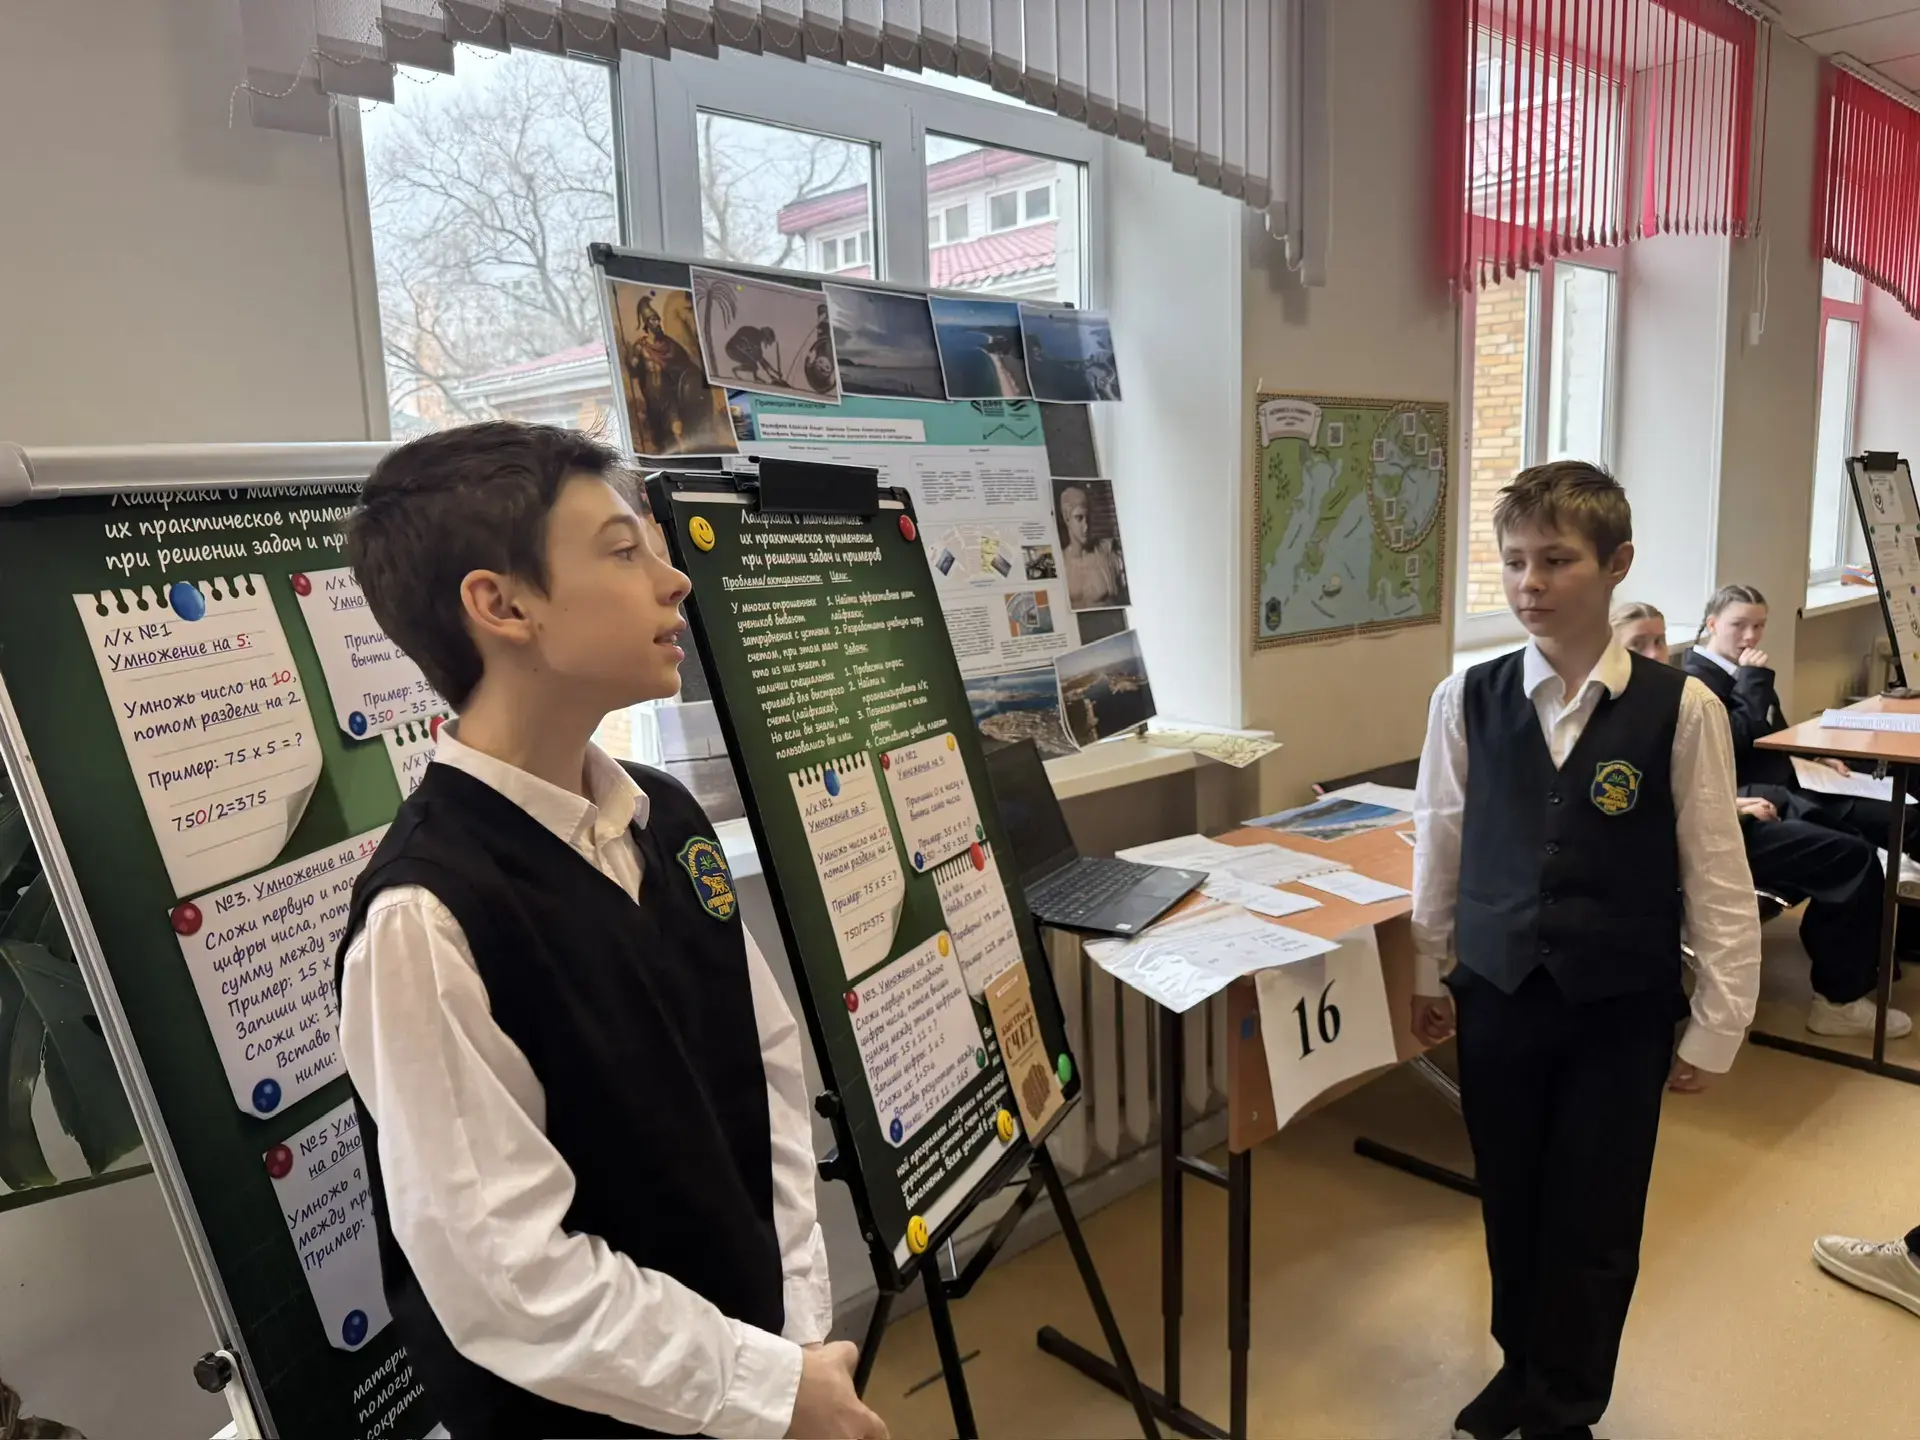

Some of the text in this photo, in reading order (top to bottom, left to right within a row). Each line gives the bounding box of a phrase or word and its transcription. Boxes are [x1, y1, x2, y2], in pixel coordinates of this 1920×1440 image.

[105, 520, 132, 539] их
[139, 511, 283, 542] практическое
[739, 532, 874, 549] их практическое применение
[106, 552, 150, 576] при
[158, 543, 247, 572] решении
[253, 533, 302, 556] задач
[307, 535, 318, 549] и
[741, 547, 882, 571] при решении задач и примеров
[731, 602, 738, 614] У
[742, 601, 771, 613] многих
[737, 612, 806, 633] учеников бывают
[138, 623, 172, 640] №1
[742, 631, 793, 648] затруднения
[801, 627, 831, 642] устным
[108, 633, 252, 671] Умножение на 5:
[351, 651, 391, 668] вычти
[747, 642, 839, 663] счетом, при этом мало
[752, 669, 769, 679] кто
[771, 666, 780, 675] из
[783, 663, 796, 673] них
[797, 660, 820, 671] знает
[757, 672, 835, 695] наличии специальных
[124, 670, 297, 719] Умножь число на 10,
[363, 683, 412, 708] Пример:
[761, 686, 845, 714] приемов для быстрого
[134, 715, 197, 741] потом
[201, 701, 260, 731] раздели
[266, 696, 283, 710] на
[369, 709, 393, 726] 350
[411, 700, 427, 714] 35
[767, 714, 791, 727] счета
[771, 716, 850, 744] Но если бы знали, то
[148, 758, 219, 790] Пример:
[225, 749, 246, 766] 75
[267, 740, 276, 755] 5
[282, 739, 291, 747] =
[295, 732, 303, 747] ?
[776, 740, 825, 759] пользовались
[826, 733, 836, 746] бы
[171, 790, 267, 832] 750/2=375
[808, 809, 850, 832] Умножение
[850, 807, 859, 817] на
[817, 845, 848, 865] Умножь
[849, 838, 868, 850] число
[869, 831, 878, 842] на
[823, 862, 850, 880] потом
[850, 849, 876, 871] раздели
[878, 846, 886, 856] на
[215, 891, 251, 914] №3.
[253, 860, 335, 900] Умножение
[339, 850, 355, 863] на
[831, 891, 862, 913] Пример:
[863, 884, 873, 895] 75
[881, 876, 886, 887] 5
[205, 920, 258, 950] Сложи
[262, 893, 315, 925] первую
[320, 889, 329, 900] и
[844, 912, 885, 942] 750/2=375
[213, 939, 267, 973] цифры
[271, 921, 317, 944] числа,
[221, 962, 274, 995] сумму
[279, 935, 325, 969] между
[228, 975, 293, 1017] Пример:
[299, 964, 317, 983] 15
[236, 1000, 298, 1040] Запиши
[245, 1027, 295, 1061] Сложи
[300, 1011, 320, 1031] их:
[1291, 978, 1341, 1061] 16
[276, 1030, 330, 1068] Вставь
[1004, 1014, 1035, 1060] СЧЕТ
[295, 1051, 337, 1084] ними:
[300, 1128, 328, 1156] №5
[308, 1135, 361, 1179] на одно
[287, 1180, 348, 1230] Умножь
[299, 1208, 346, 1251] между
[304, 1218, 365, 1271] Пример:
[353, 1346, 408, 1404] матери
